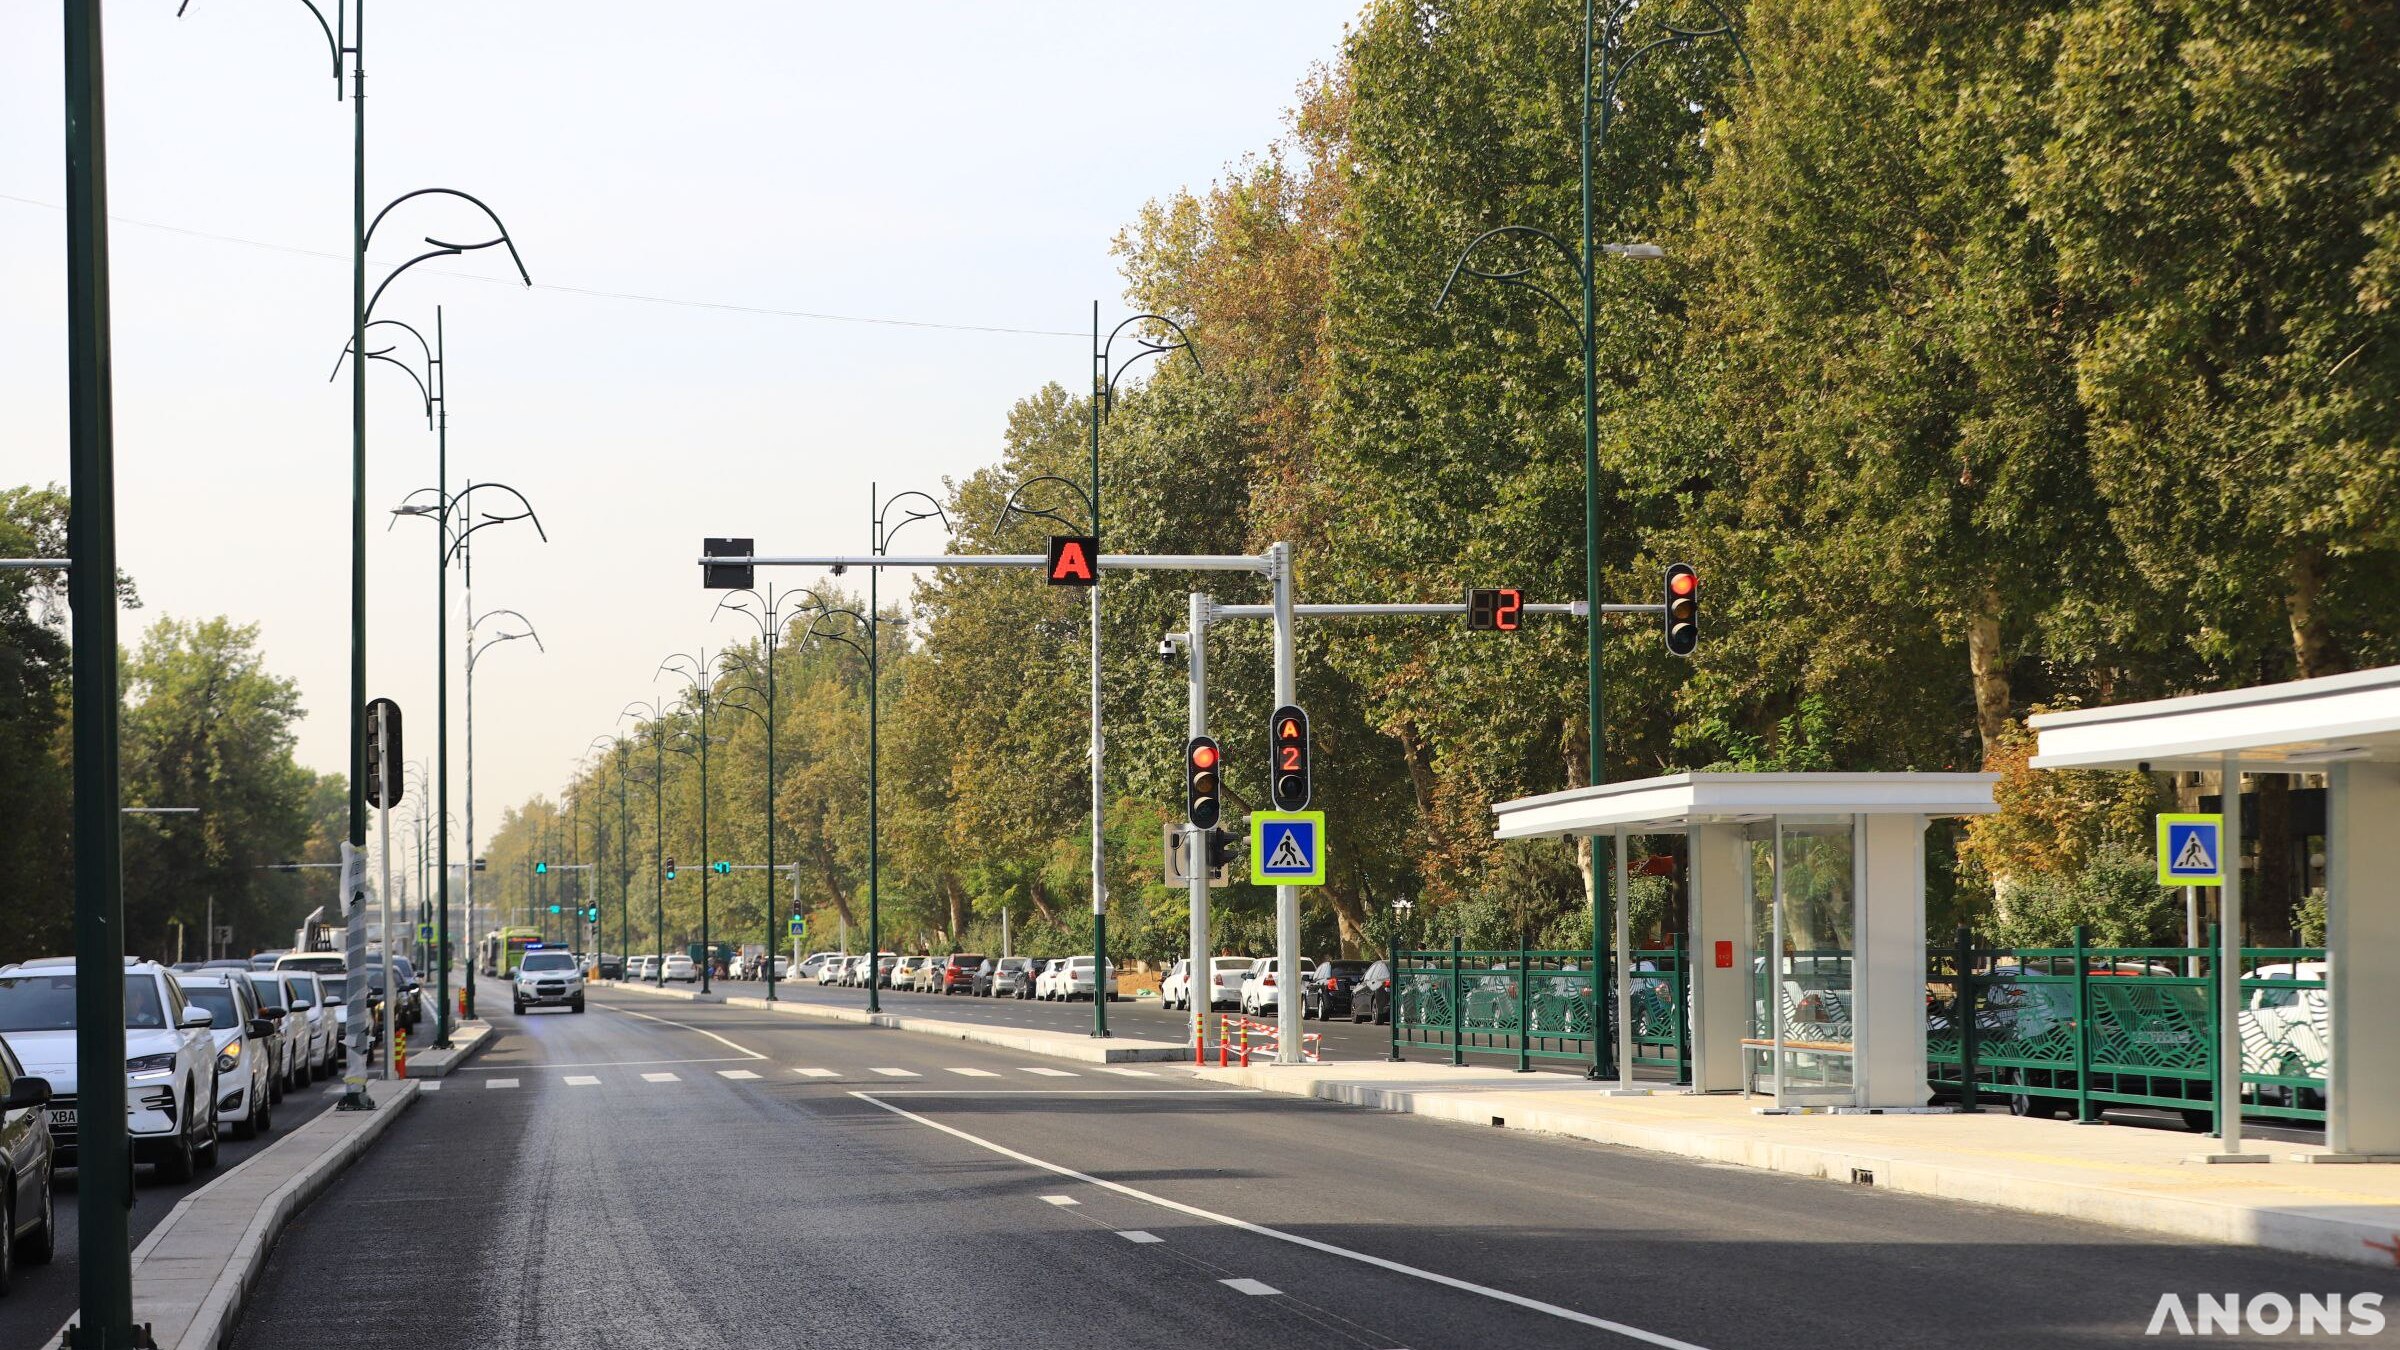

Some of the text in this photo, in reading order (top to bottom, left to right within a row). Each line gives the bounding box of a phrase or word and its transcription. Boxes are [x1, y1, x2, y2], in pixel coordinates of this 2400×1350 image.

[1053, 542, 1091, 579] A
[1496, 589, 1520, 630] 2
[1282, 720, 1298, 738] A
[1282, 747, 1299, 770] 2
[536, 862, 547, 873] A
[51, 1110, 76, 1123] XBA
